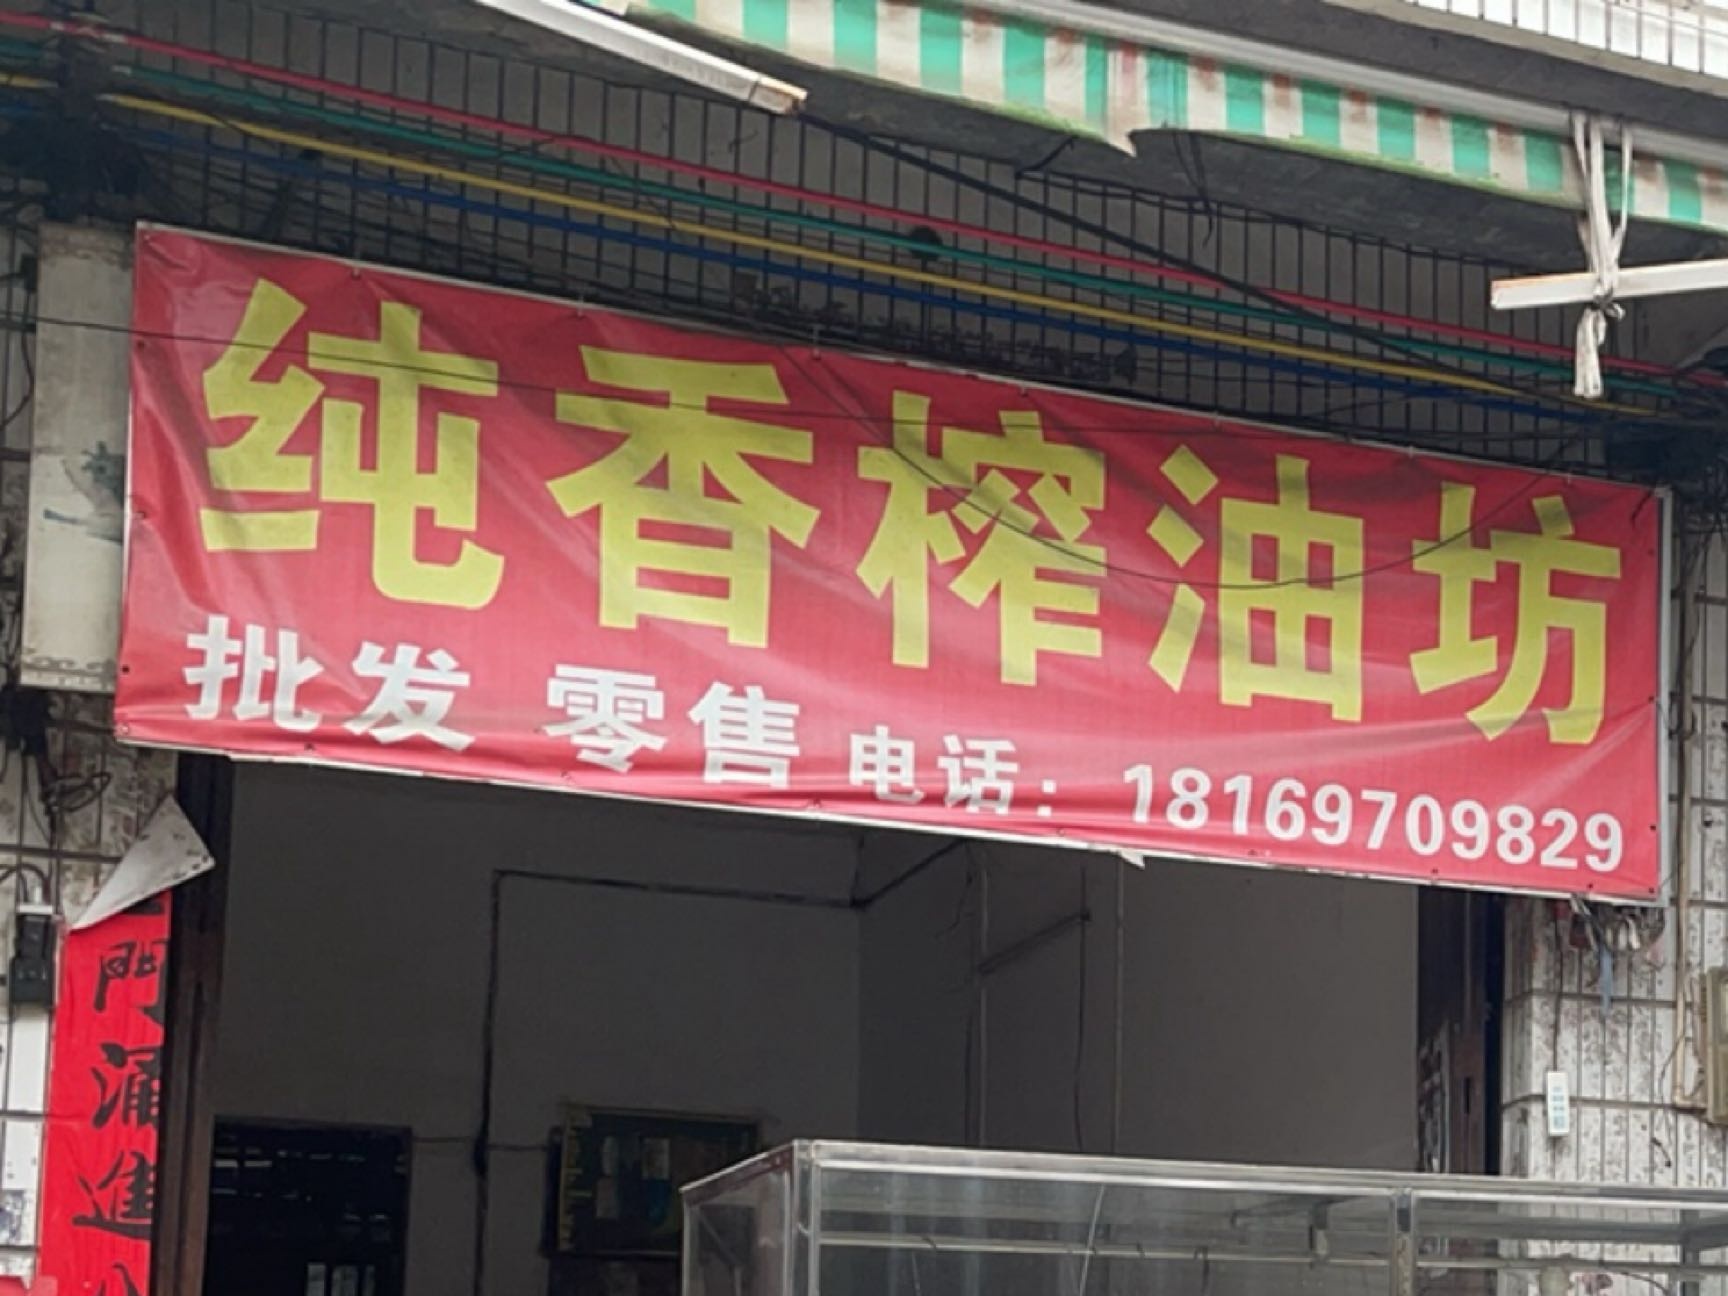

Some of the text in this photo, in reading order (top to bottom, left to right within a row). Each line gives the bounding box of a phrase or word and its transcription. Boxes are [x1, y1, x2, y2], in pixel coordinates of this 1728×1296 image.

[199, 278, 1622, 745] 纯香榨油坊
[184, 614, 474, 752] 批发
[546, 664, 803, 791] 零售
[1123, 764, 1625, 873] 18169709829
